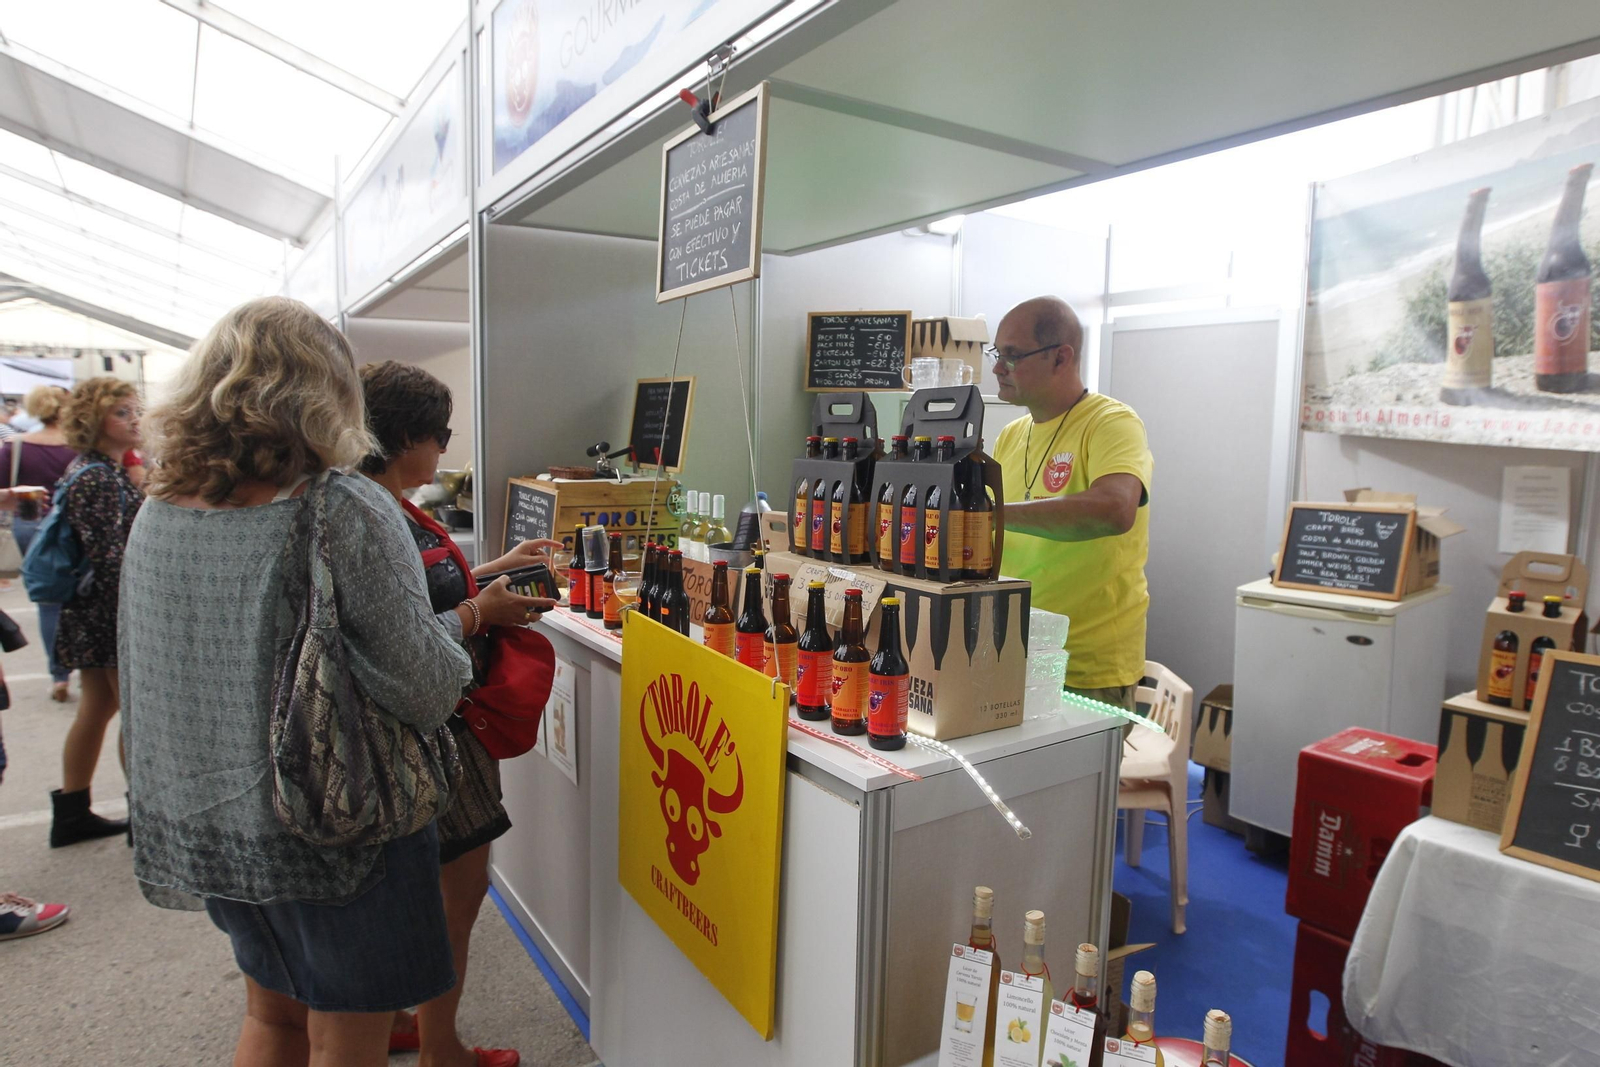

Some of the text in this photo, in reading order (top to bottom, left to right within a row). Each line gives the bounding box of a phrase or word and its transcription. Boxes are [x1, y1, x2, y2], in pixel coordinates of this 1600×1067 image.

[668, 139, 756, 193] CERVEZAS ARTESANAS
[669, 165, 748, 212] COSTA DE ALMERIA
[670, 196, 743, 239] SE PUEDE PAGAR
[668, 221, 741, 262] CON EFECTIVO Y
[675, 248, 729, 282] TICKETS
[1305, 524, 1334, 532] CRAFT
[1301, 535, 1328, 543] COSTA
[1345, 537, 1379, 549] ALMERIA
[1354, 555, 1386, 566] GOLDEN
[805, 566, 825, 576] CRAFT
[1301, 568, 1315, 576] ALL
[1320, 570, 1339, 579] REAL
[1357, 565, 1383, 575] STOUT
[850, 578, 875, 594] BEERS
[909, 676, 934, 698] VEZA
[908, 692, 934, 716] SANA
[979, 699, 1022, 713] 12 BOTELLAS
[995, 712, 1008, 720] 330
[1314, 809, 1342, 877] Damm
[651, 864, 718, 947] CRAFTBEERS
[967, 980, 982, 988] natural
[1003, 1001, 1037, 1014] 100% natural
[1050, 1028, 1070, 1041] Chocolate
[1074, 1039, 1088, 1048] Menta
[1064, 1026, 1075, 1035] Licor
[1053, 1038, 1082, 1053] 100% natural
